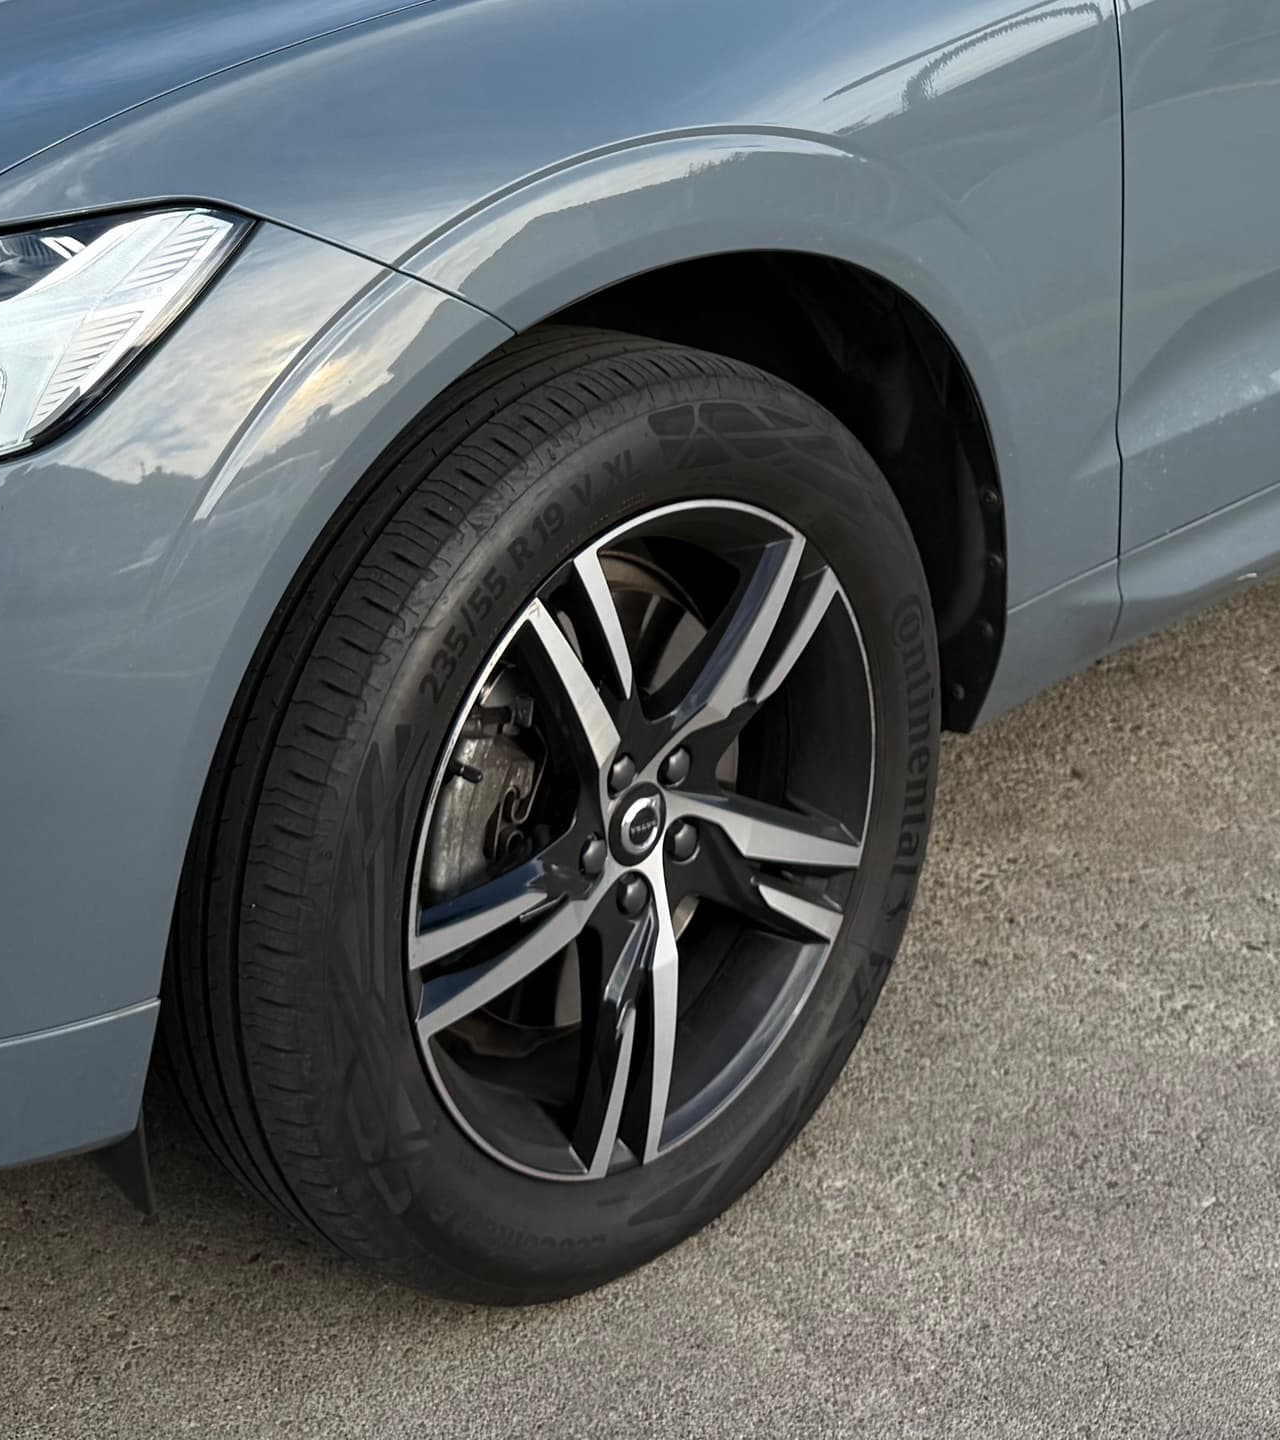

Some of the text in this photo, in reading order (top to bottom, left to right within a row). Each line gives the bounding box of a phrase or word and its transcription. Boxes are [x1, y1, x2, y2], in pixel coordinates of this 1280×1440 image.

[419, 448, 644, 704] 235/55 R 19 V XL
[890, 593, 934, 879] Continental
